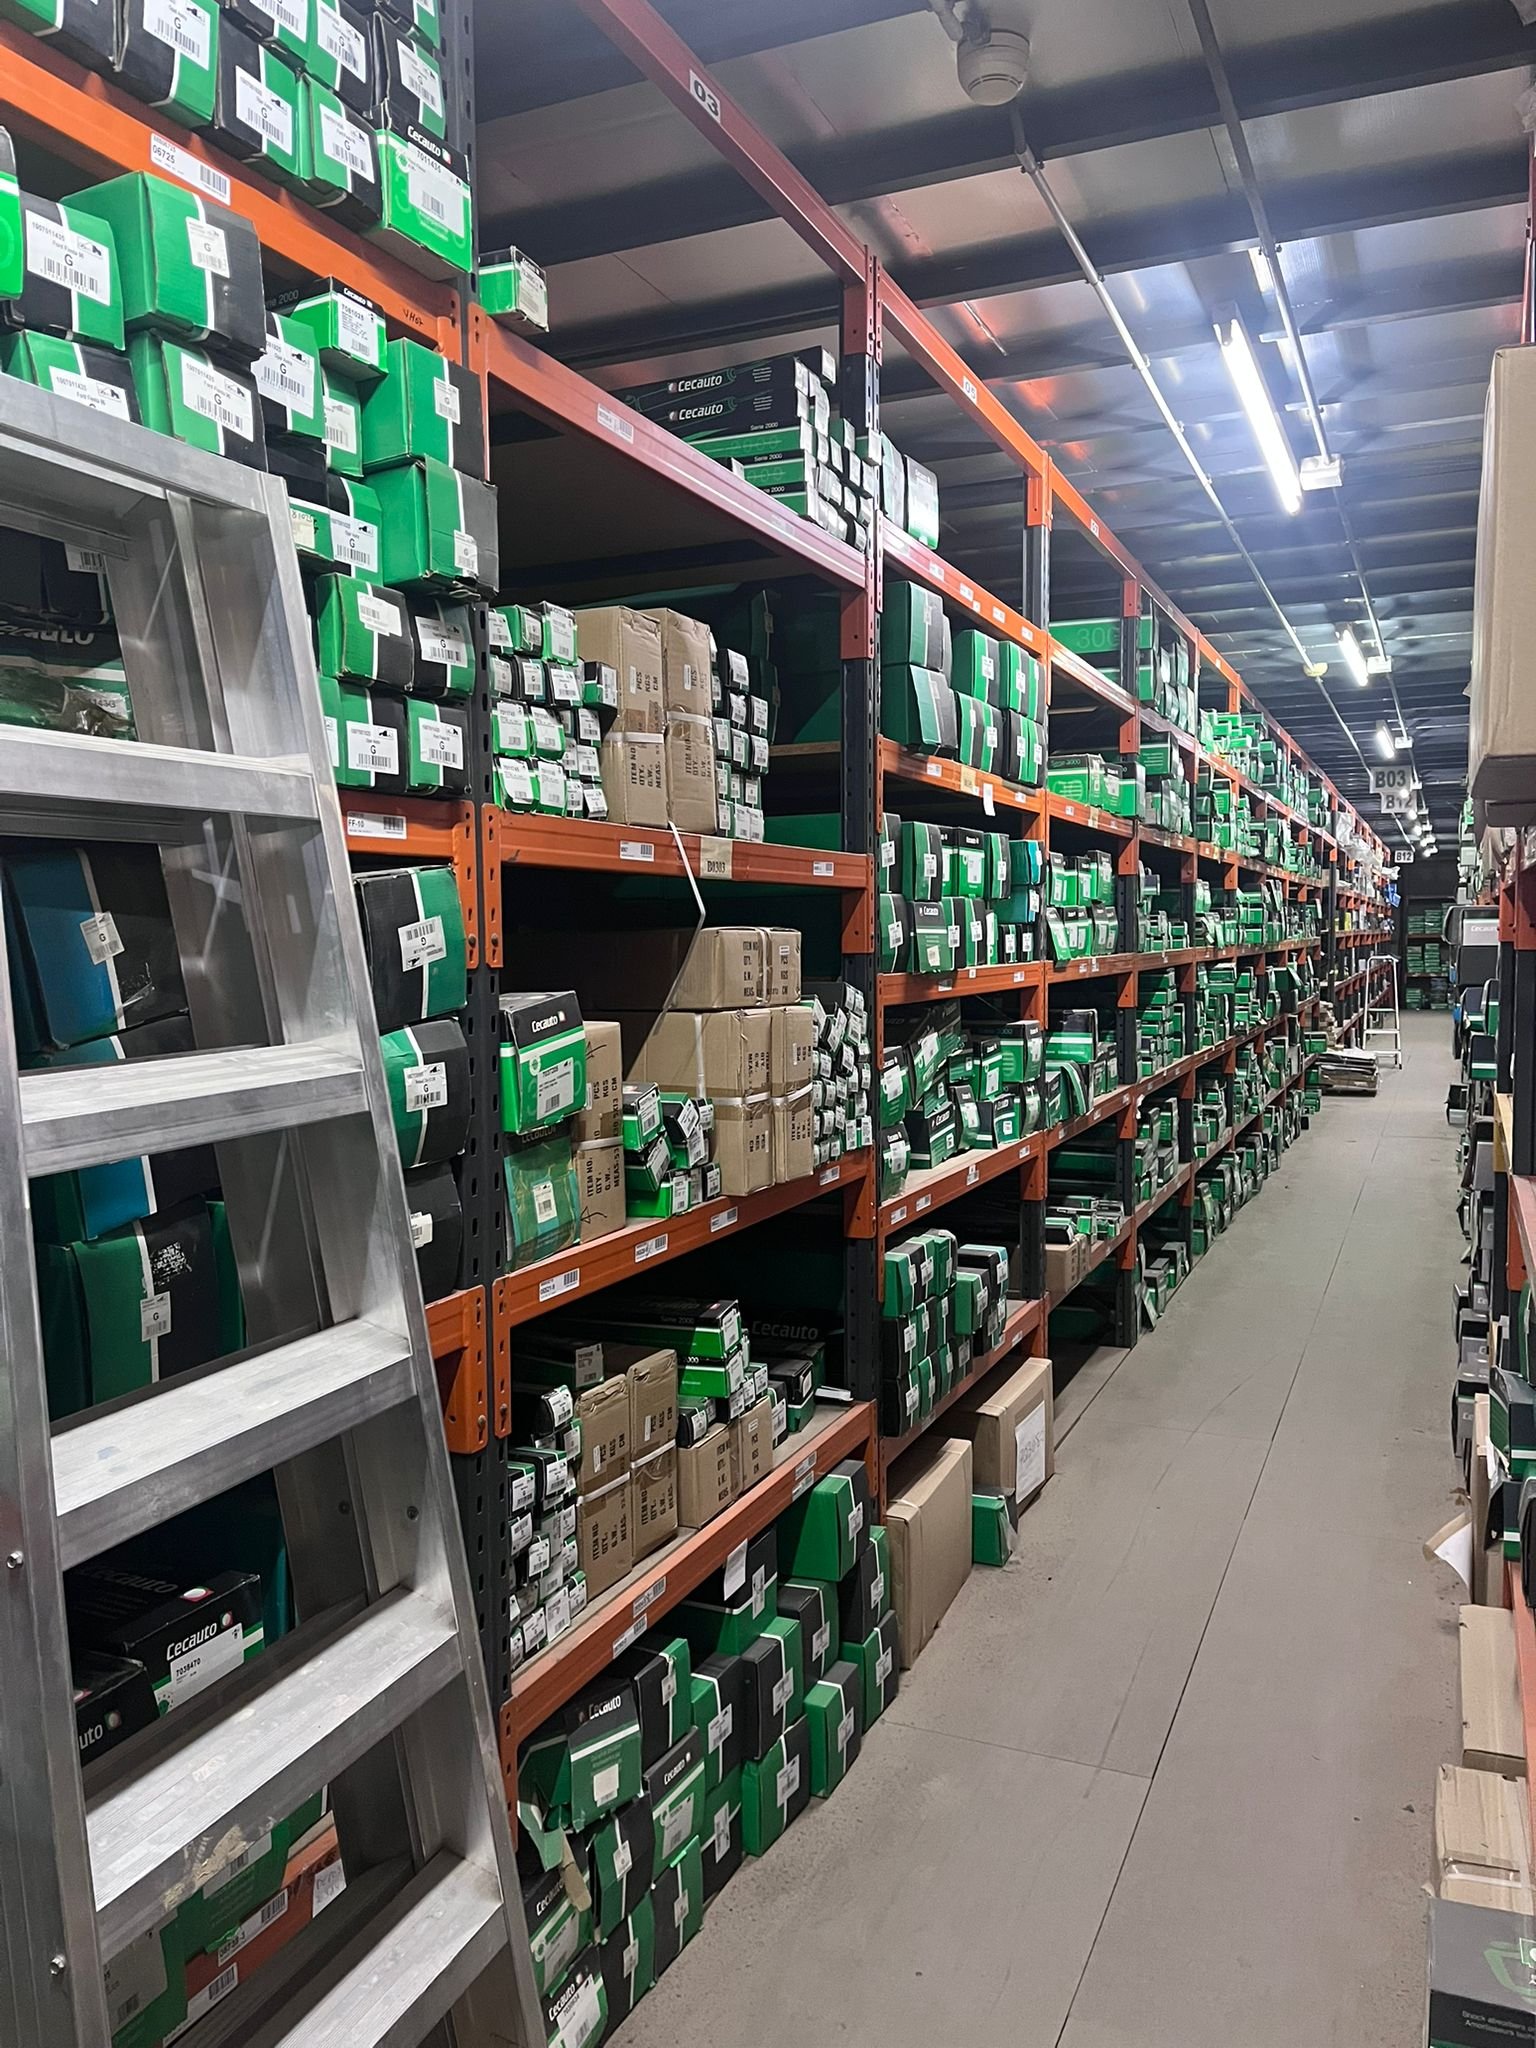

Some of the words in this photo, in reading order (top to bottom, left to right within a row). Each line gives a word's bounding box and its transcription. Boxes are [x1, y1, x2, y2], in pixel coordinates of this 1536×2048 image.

[174, 17, 181, 29] G
[694, 79, 719, 117] 03
[261, 107, 268, 119] G
[345, 140, 352, 151] G
[407, 125, 441, 157] Cecauto
[152, 144, 176, 164] 06725
[203, 243, 211, 252] G
[64, 253, 74, 267] G
[280, 363, 287, 375] G
[677, 375, 723, 393] Cecauto
[214, 394, 222, 405] G
[679, 403, 724, 421] Cecauto
[349, 538, 355, 548] G
[440, 639, 447, 648] G
[370, 744, 376, 755] G
[439, 741, 445, 750] G
[1375, 769, 1406, 788] B03
[1396, 852, 1412, 861] B12
[707, 860, 726, 873] B0303
[99, 933, 106, 942] G
[420, 937, 427, 946] G
[531, 1014, 559, 1033] Cecauto
[423, 1083, 429, 1093] G
[611, 1076, 617, 1091] CM
[586, 1176, 594, 1197] ITEM
[153, 1312, 160, 1321] G
[751, 1319, 819, 1341] Cecauto
[166, 1622, 218, 1662] Cecauto
[588, 1695, 622, 1720] Cecauto
[663, 1760, 686, 1785] Cecauto
[548, 1983, 576, 2022] Cecauto
